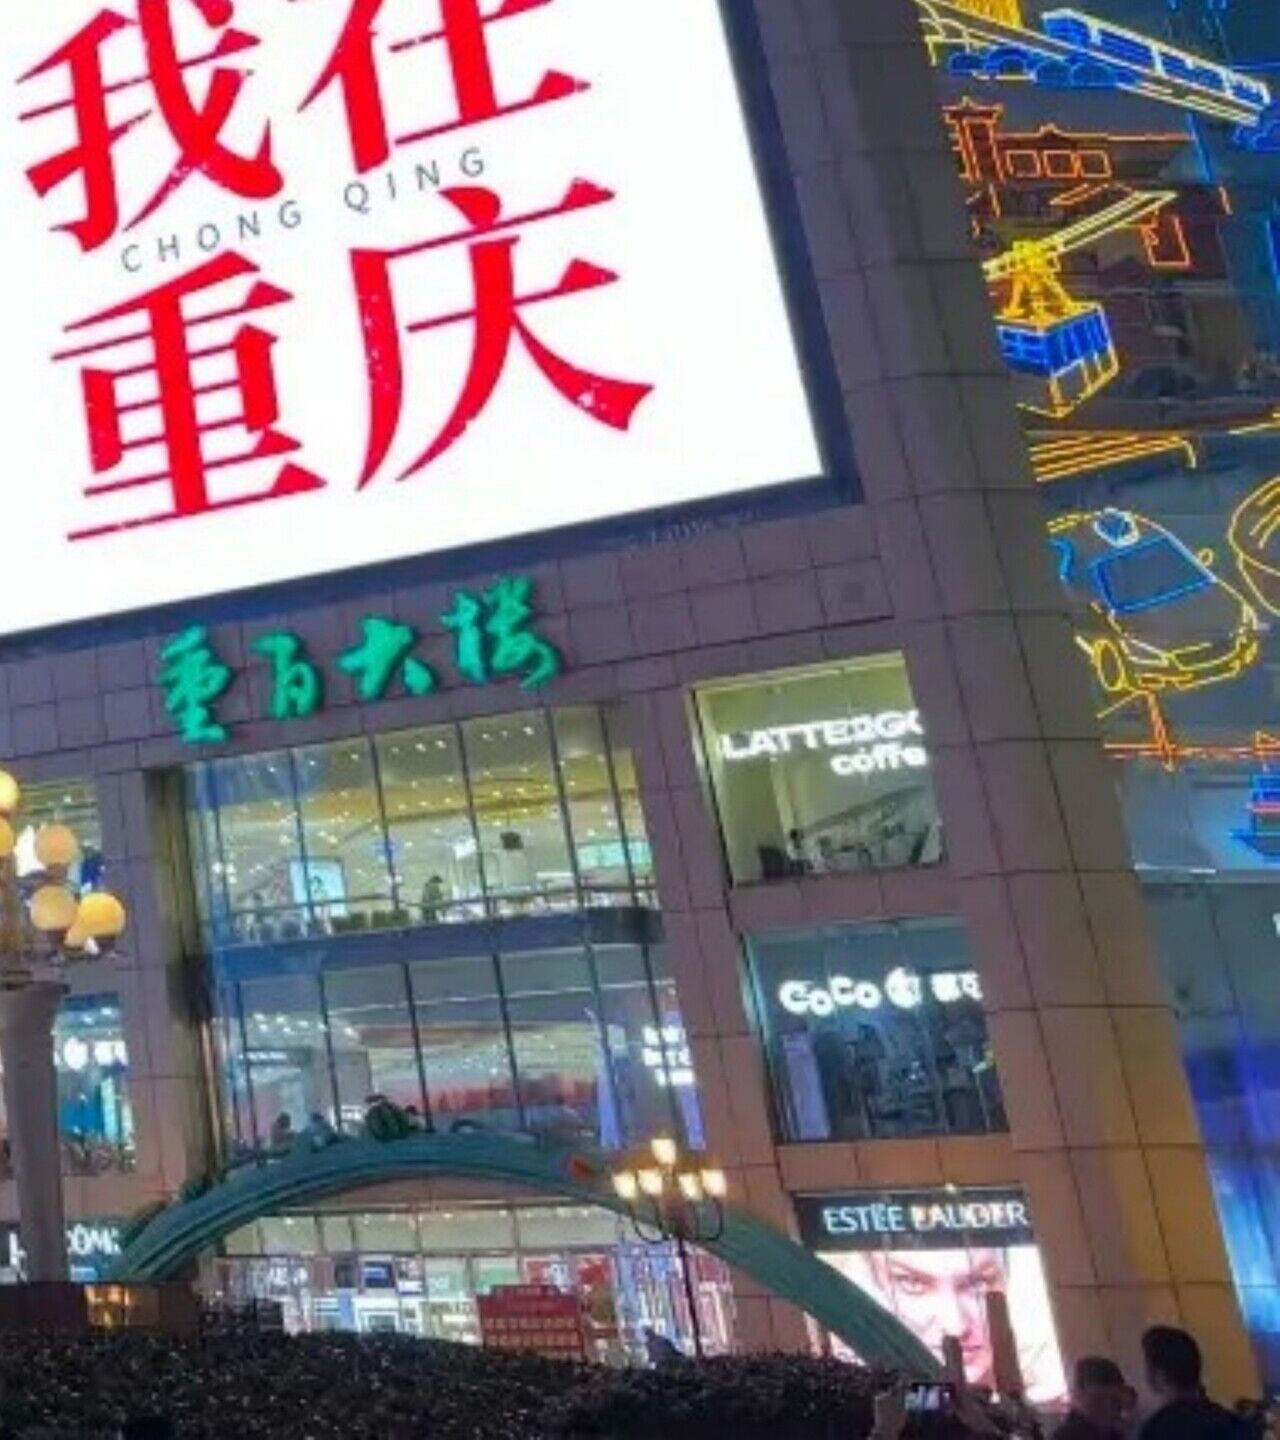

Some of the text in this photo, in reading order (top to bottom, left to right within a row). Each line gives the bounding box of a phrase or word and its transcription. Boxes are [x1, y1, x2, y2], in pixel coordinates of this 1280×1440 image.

[119, 147, 486, 273] CHONG QING
[50, 175, 655, 542] 重庆
[778, 973, 883, 1017] CoCo
[909, 1199, 1030, 1232] LAUDER
